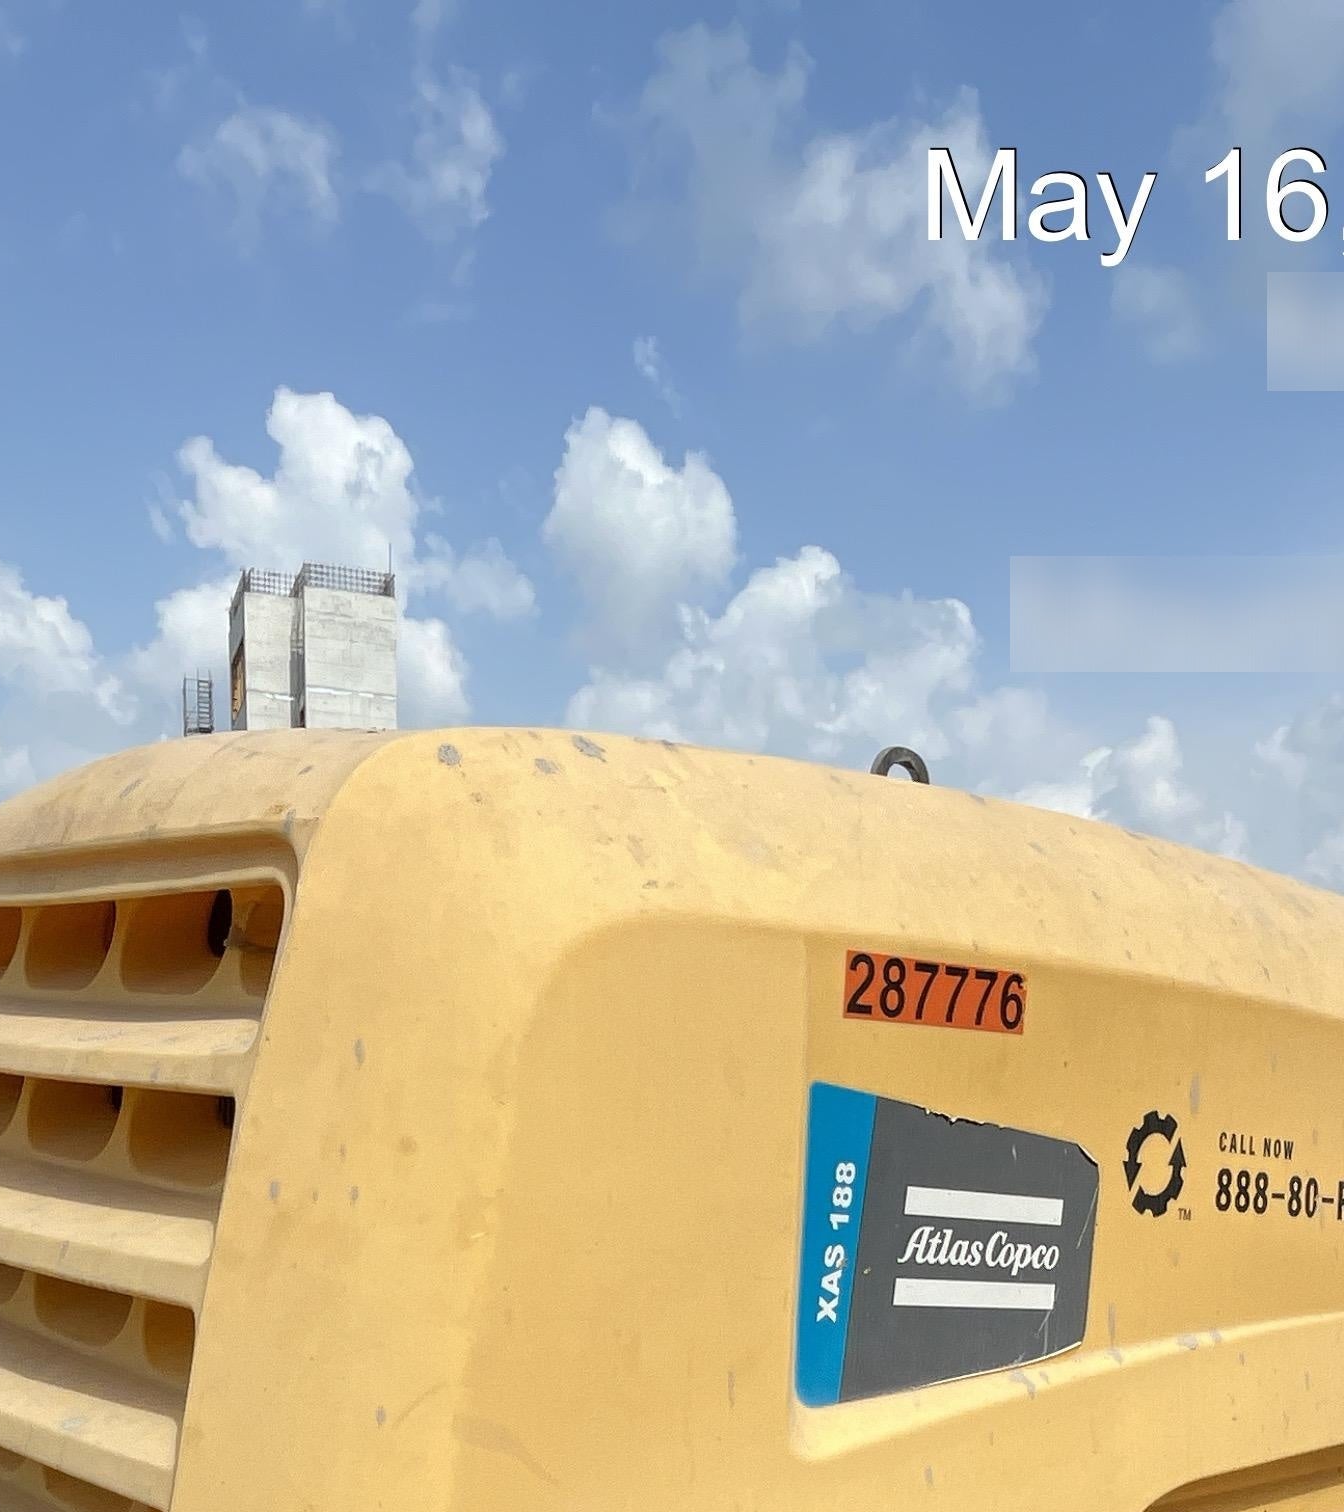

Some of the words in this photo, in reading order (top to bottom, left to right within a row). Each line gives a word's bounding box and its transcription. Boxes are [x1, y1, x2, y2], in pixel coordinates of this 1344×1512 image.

[847, 953, 1024, 1030] 287776
[1218, 1131, 1256, 1156] CALL
[1263, 1137, 1294, 1160] NOW
[829, 1162, 857, 1231] 188
[816, 1244, 846, 1323] XAS
[896, 1225, 983, 1267] Atlas
[984, 1230, 1060, 1276] Copco
